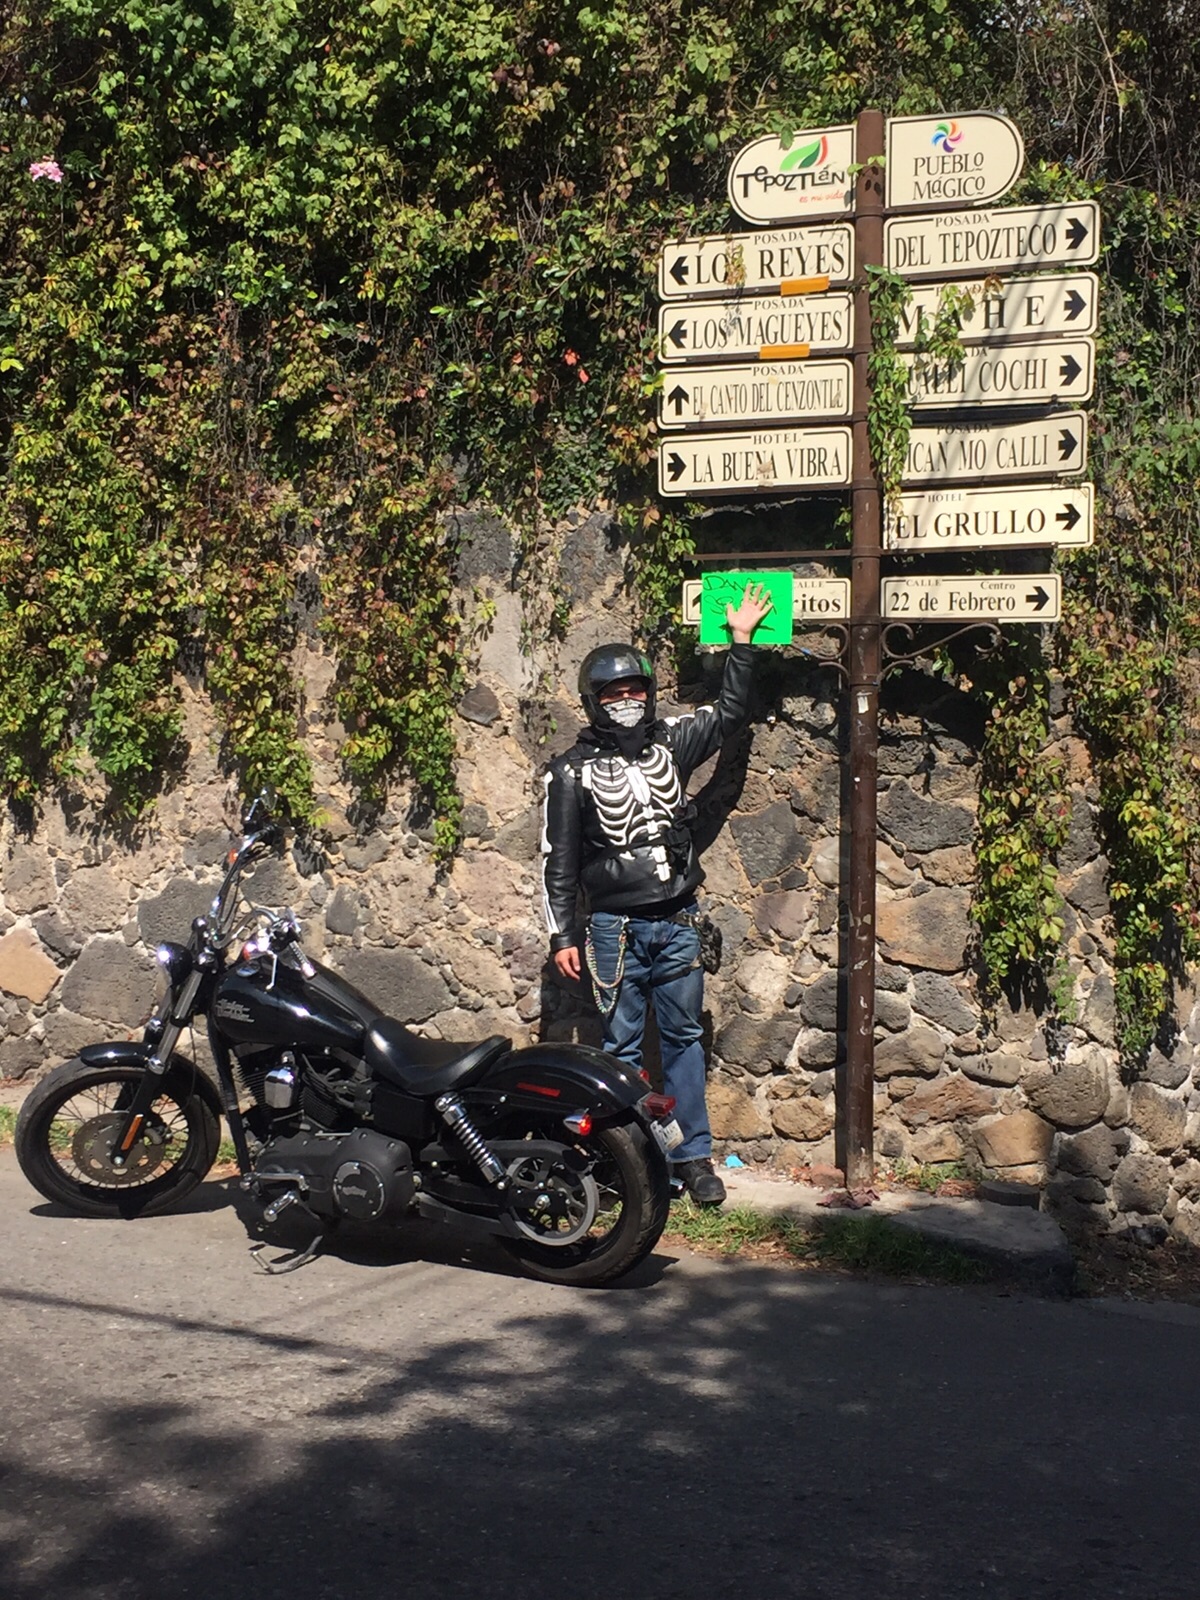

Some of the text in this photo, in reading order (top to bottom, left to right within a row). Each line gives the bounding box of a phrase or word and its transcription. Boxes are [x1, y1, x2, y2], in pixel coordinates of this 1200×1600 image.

[935, 213, 990, 228] POSADA
[754, 231, 805, 245] POSADA
[894, 223, 1057, 268] DEL TEPOZTECO
[695, 243, 845, 285] LO REYES
[754, 298, 805, 310] POSADA
[692, 310, 843, 350] LOS MAGUEYES
[753, 365, 804, 377] POSADA
[906, 358, 1048, 397] UALLI COCHI
[693, 378, 844, 416] EL CANTO DEL CENZONTLE
[753, 433, 802, 445] HOTEL
[936, 423, 991, 436] POSADA
[906, 434, 1048, 474] ICAN MO CALLI
[692, 446, 842, 484] LA BUENA VIBRA
[928, 493, 963, 503] HOTEL
[896, 508, 1046, 540] EL GRULLO
[906, 579, 1016, 591] CALLE Centro
[891, 591, 1016, 612] 22 de Febrero
